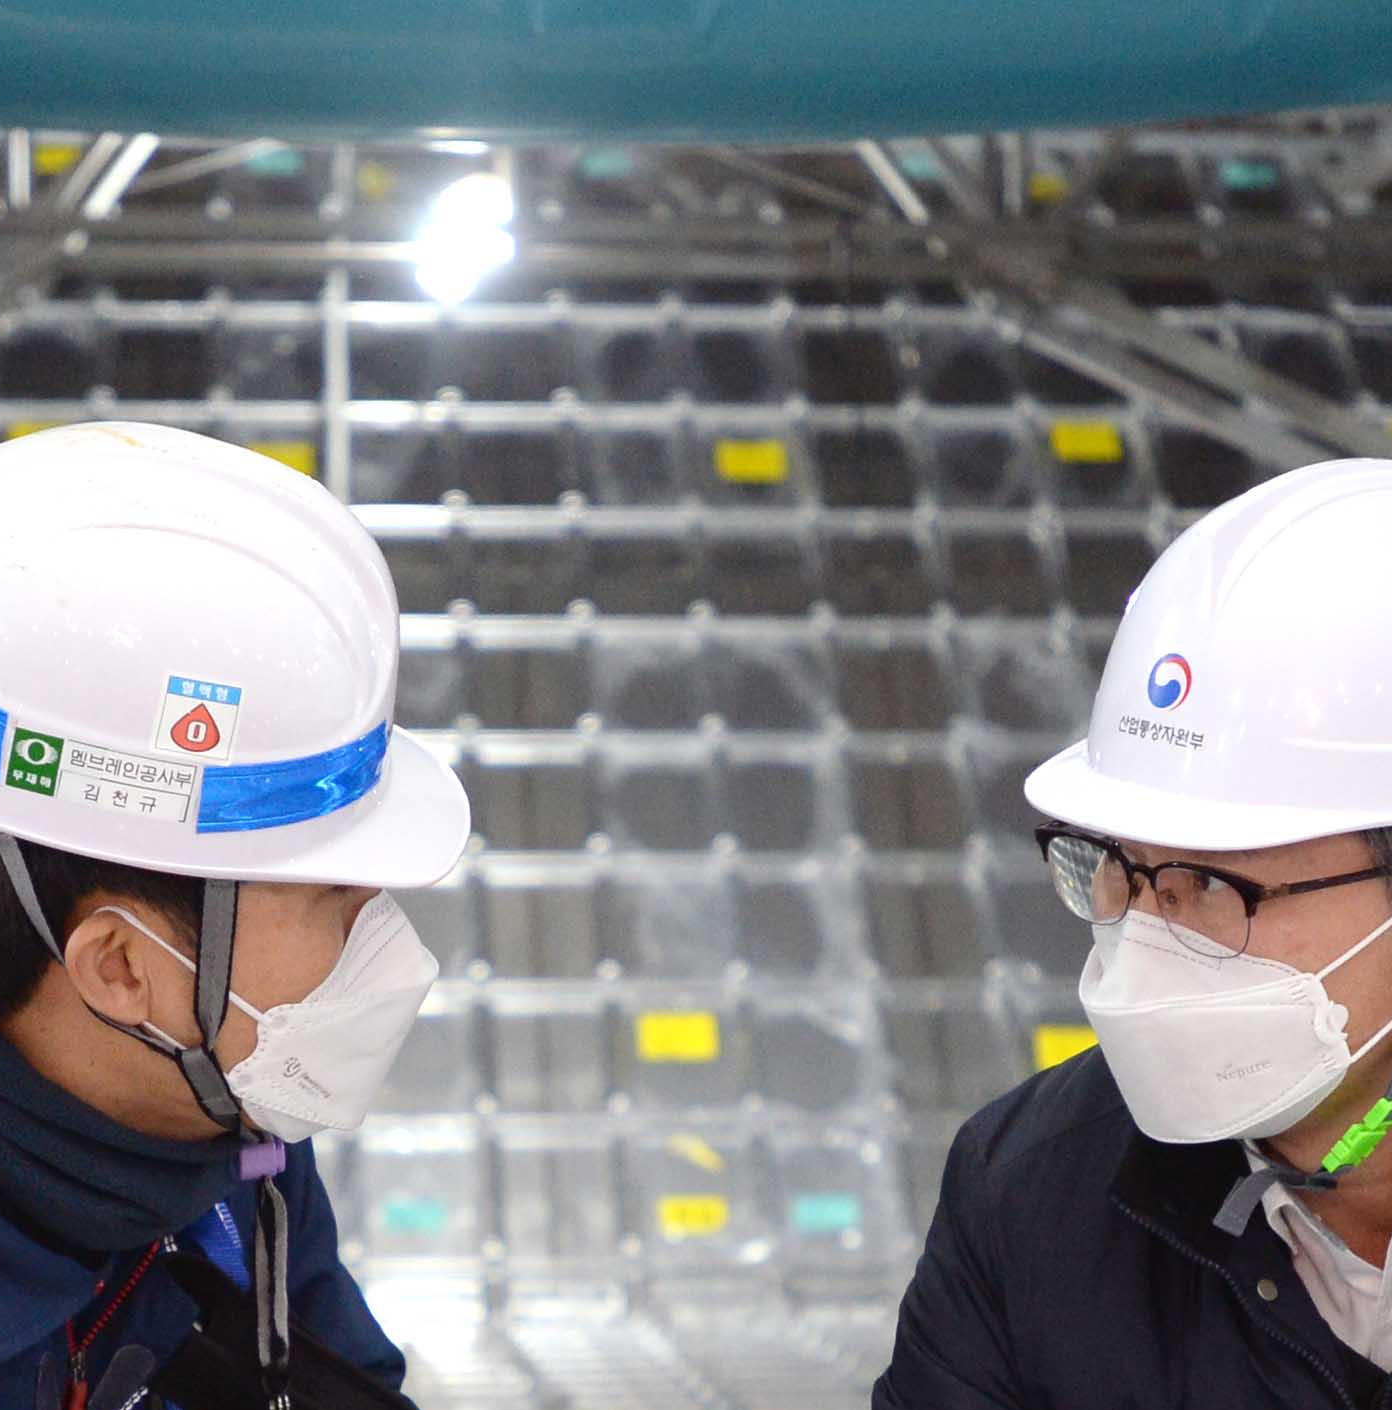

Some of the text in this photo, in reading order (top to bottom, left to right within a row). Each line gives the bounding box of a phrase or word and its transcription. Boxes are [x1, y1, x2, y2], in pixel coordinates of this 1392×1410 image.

[1118, 715, 1205, 750] 산업통상자원부
[12, 769, 52, 789] 무재해
[69, 748, 193, 789] 멤브레인공사부
